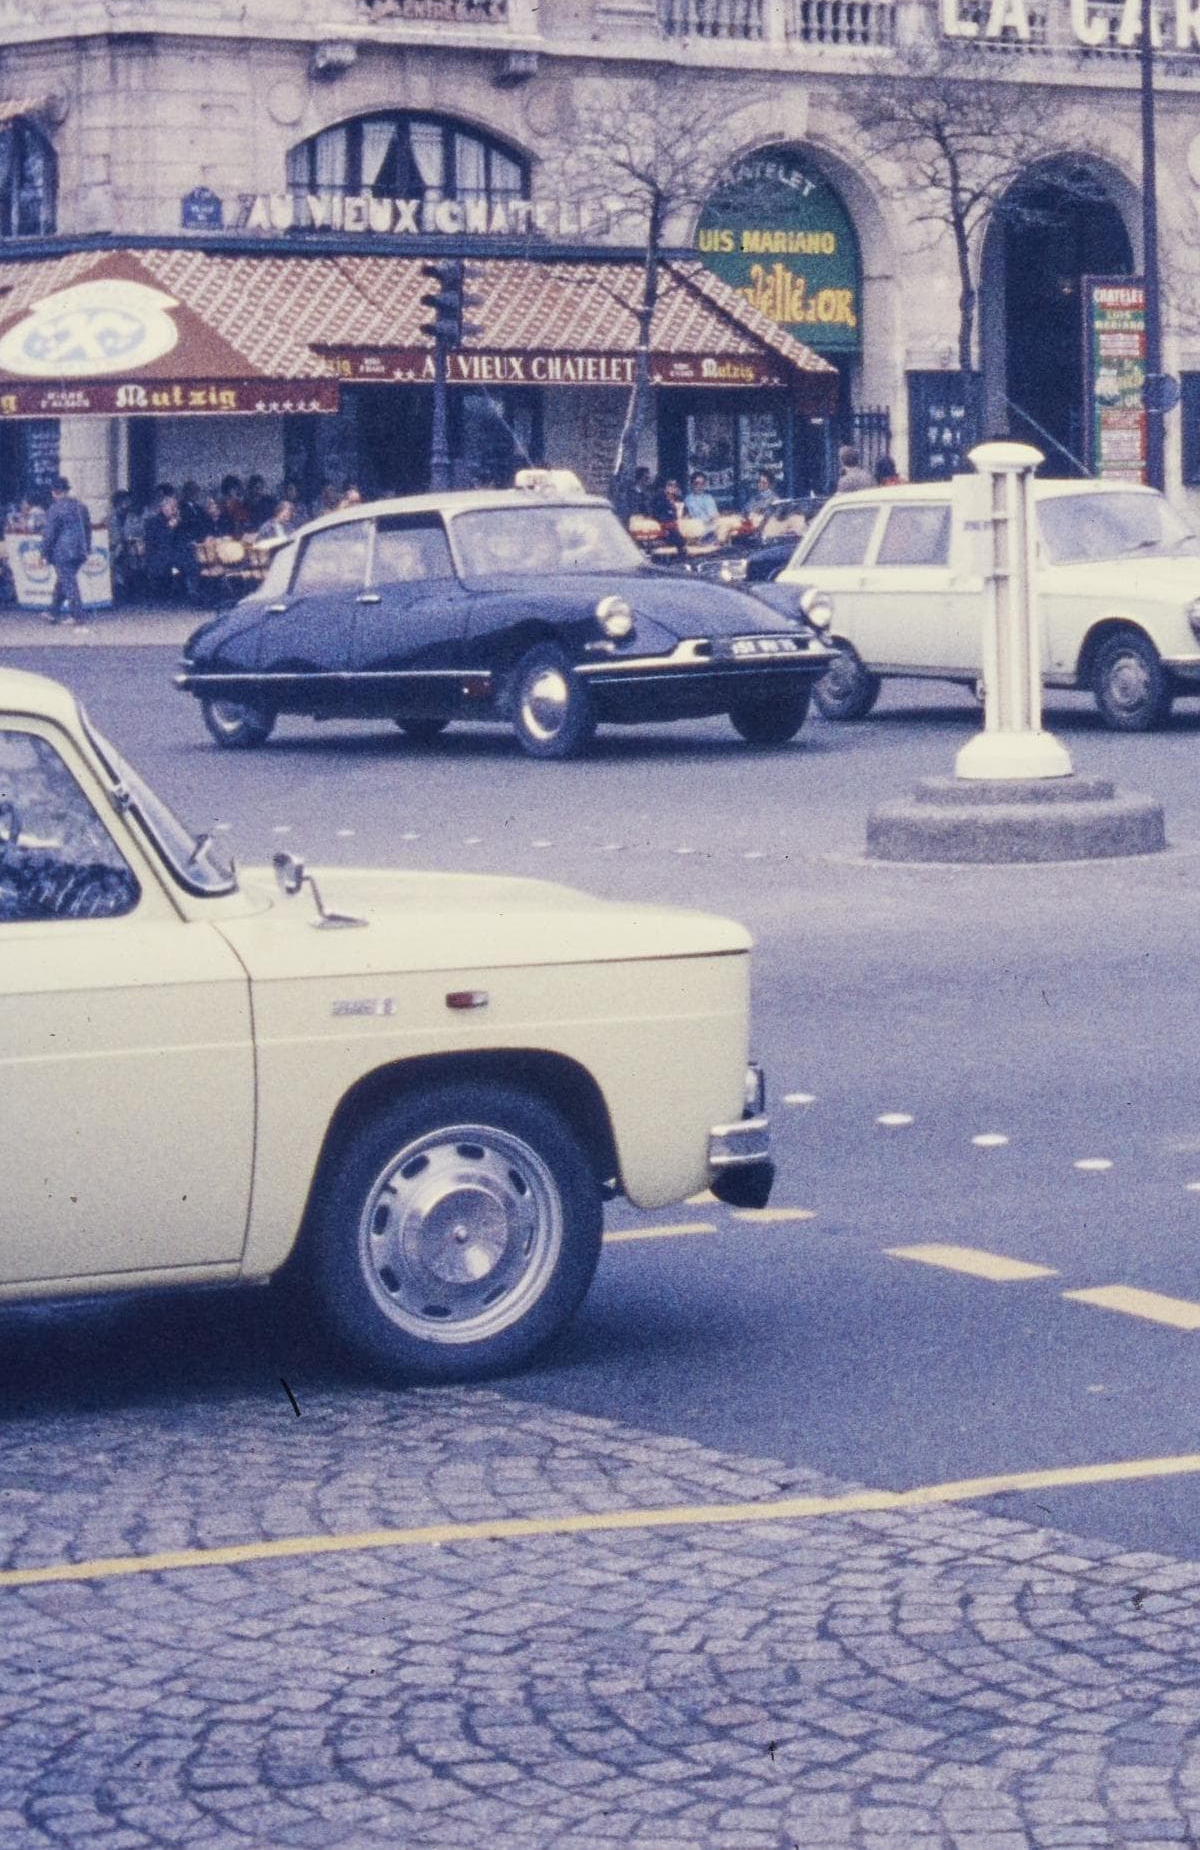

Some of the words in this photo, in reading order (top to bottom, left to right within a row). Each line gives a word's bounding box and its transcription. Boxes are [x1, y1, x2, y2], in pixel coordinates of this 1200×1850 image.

[246, 193, 294, 231] AU
[305, 194, 422, 233] VIEUX
[699, 229, 734, 252] UIS
[742, 230, 837, 255] MARIANO
[1093, 287, 1145, 304] CHATELET
[457, 354, 524, 379] VIEUX
[531, 356, 635, 381] CHATELET
[115, 383, 237, 411] Mutzig
